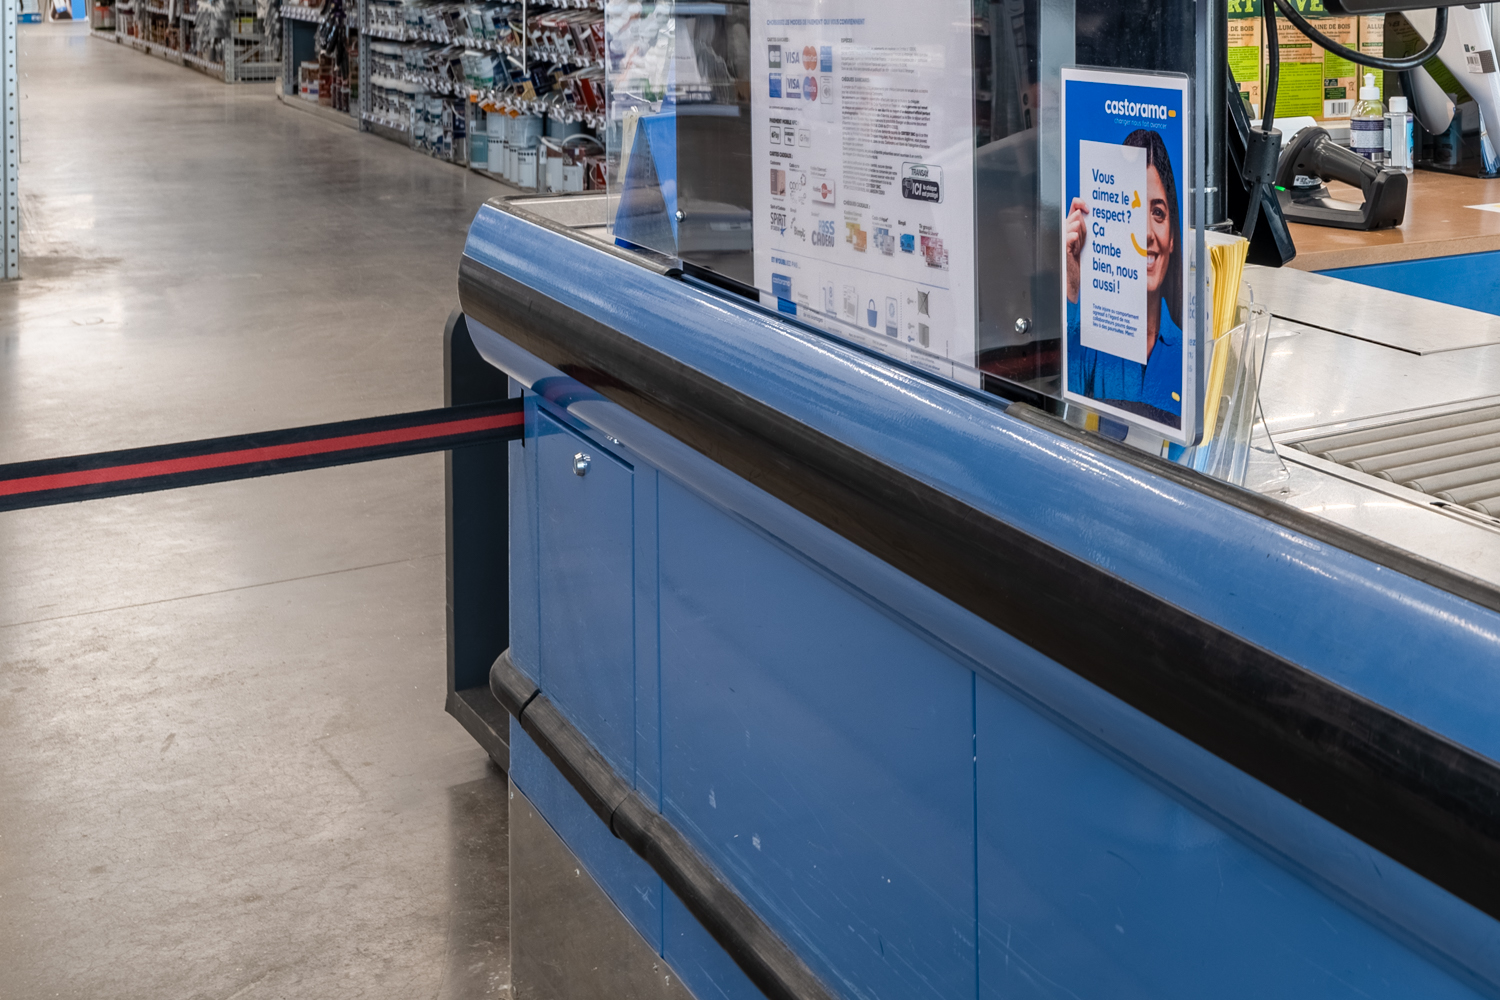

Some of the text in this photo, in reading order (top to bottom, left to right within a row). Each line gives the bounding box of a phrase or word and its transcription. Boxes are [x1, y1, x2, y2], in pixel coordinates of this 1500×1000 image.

[785, 51, 800, 64] VISA
[787, 78, 800, 89] VISA
[1104, 98, 1168, 120] castorama
[1113, 117, 1131, 127] changer
[1142, 120, 1150, 128] fait
[1150, 121, 1168, 130] avancer
[1092, 168, 1115, 186] Vous
[1092, 187, 1130, 206] aimez le
[1092, 206, 1132, 224] respect ?
[1092, 221, 1105, 238] Ça
[1092, 240, 1121, 258] tombe
[1092, 257, 1139, 281] bien, nous
[1092, 278, 1116, 294] aussi
